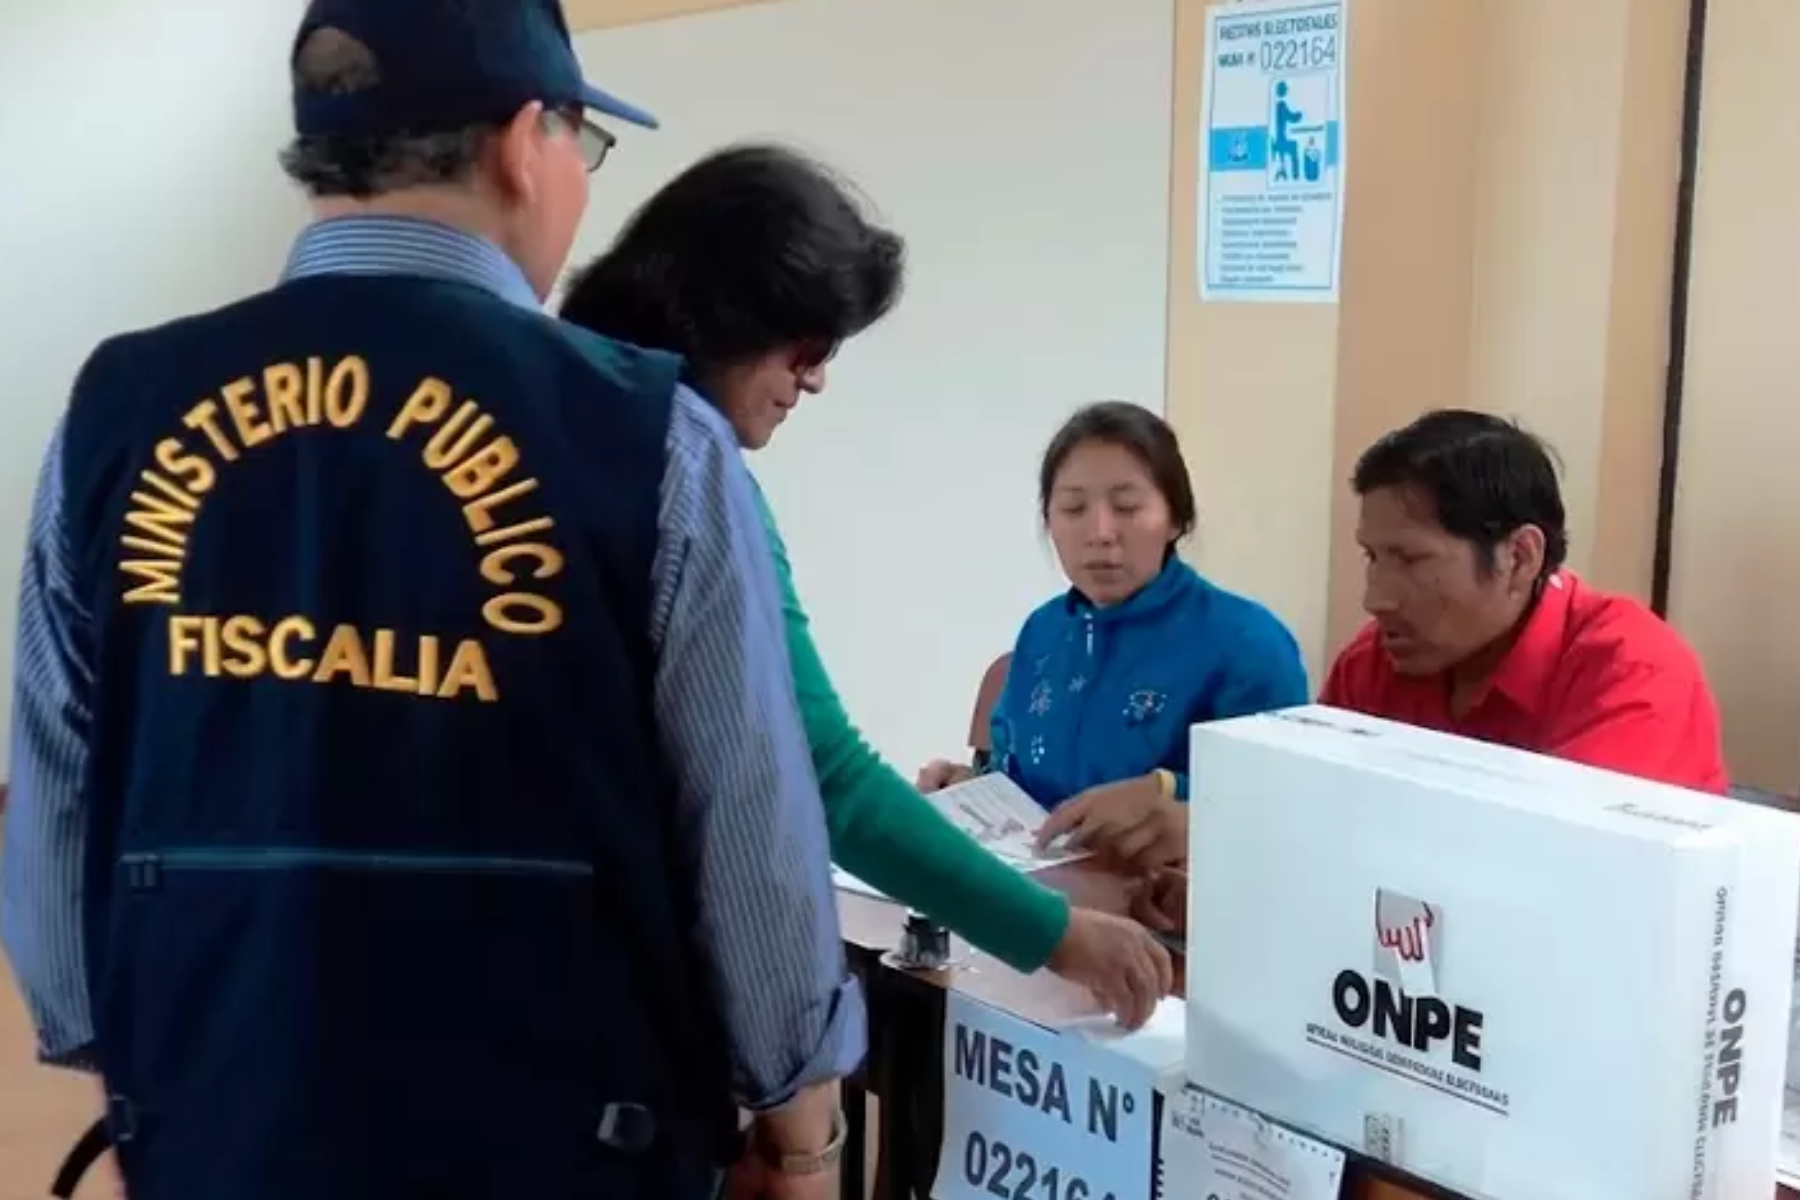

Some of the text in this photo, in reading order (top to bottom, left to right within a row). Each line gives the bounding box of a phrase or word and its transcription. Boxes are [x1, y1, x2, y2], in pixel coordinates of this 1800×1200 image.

[1260, 36, 1336, 70] 022164
[119, 355, 565, 634] MINISTERIO PUBLICO
[168, 614, 498, 702] FISCALIA
[1332, 968, 1484, 1073] ONPE
[1712, 988, 1746, 1128] ONPE
[955, 1023, 1072, 1124] MESA
